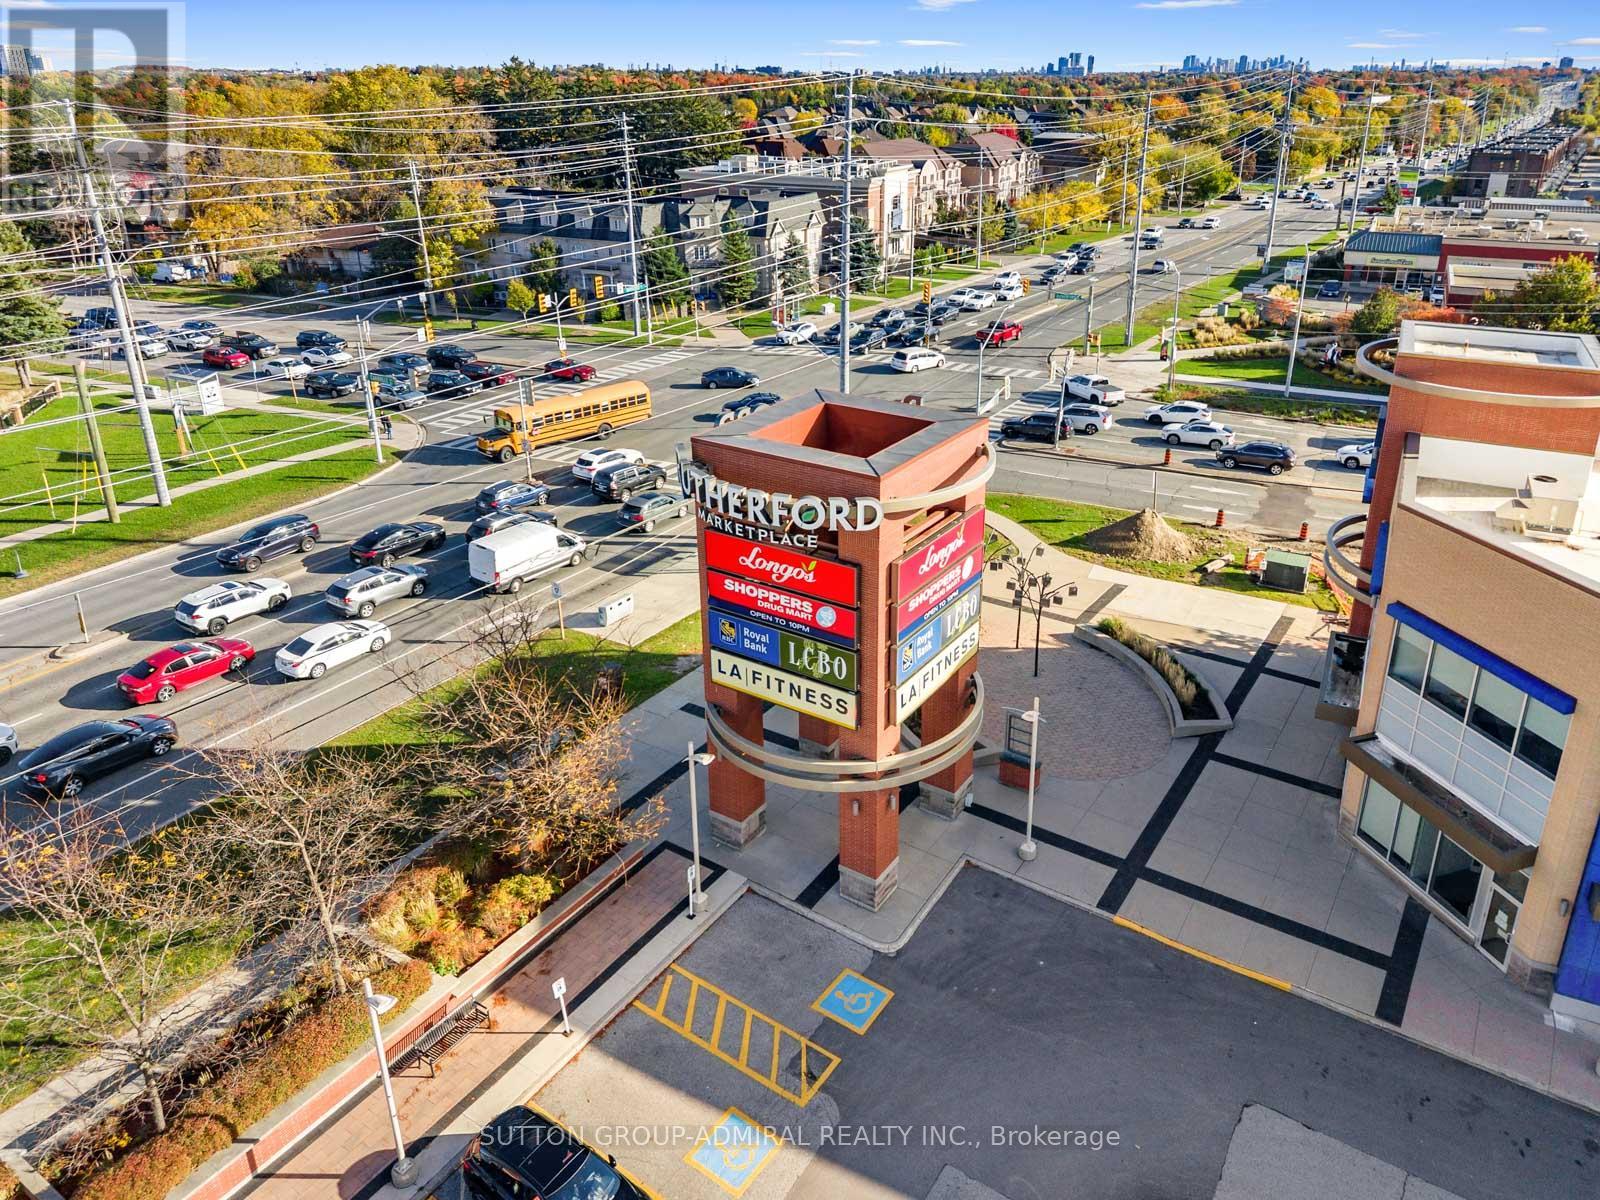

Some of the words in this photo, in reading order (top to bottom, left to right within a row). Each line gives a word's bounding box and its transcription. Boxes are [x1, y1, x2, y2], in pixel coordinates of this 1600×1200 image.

[699, 508, 818, 548] MARKETPLACE
[724, 578, 813, 613] SHOPPERS
[907, 565, 962, 612] SHOPPERS
[750, 610, 774, 622] OPEN
[775, 618, 786, 629] TO
[788, 621, 811, 633] 10PM
[757, 599, 785, 613] DRUG
[785, 606, 813, 622] MART
[945, 594, 978, 638] LCBO
[743, 627, 770, 644] Royal
[743, 639, 768, 655] Bank
[788, 640, 847, 680] LCBO
[900, 684, 917, 709] LA
[922, 631, 977, 689] FITNESS
[717, 659, 742, 681] LA
[751, 670, 848, 716] FITNESS
